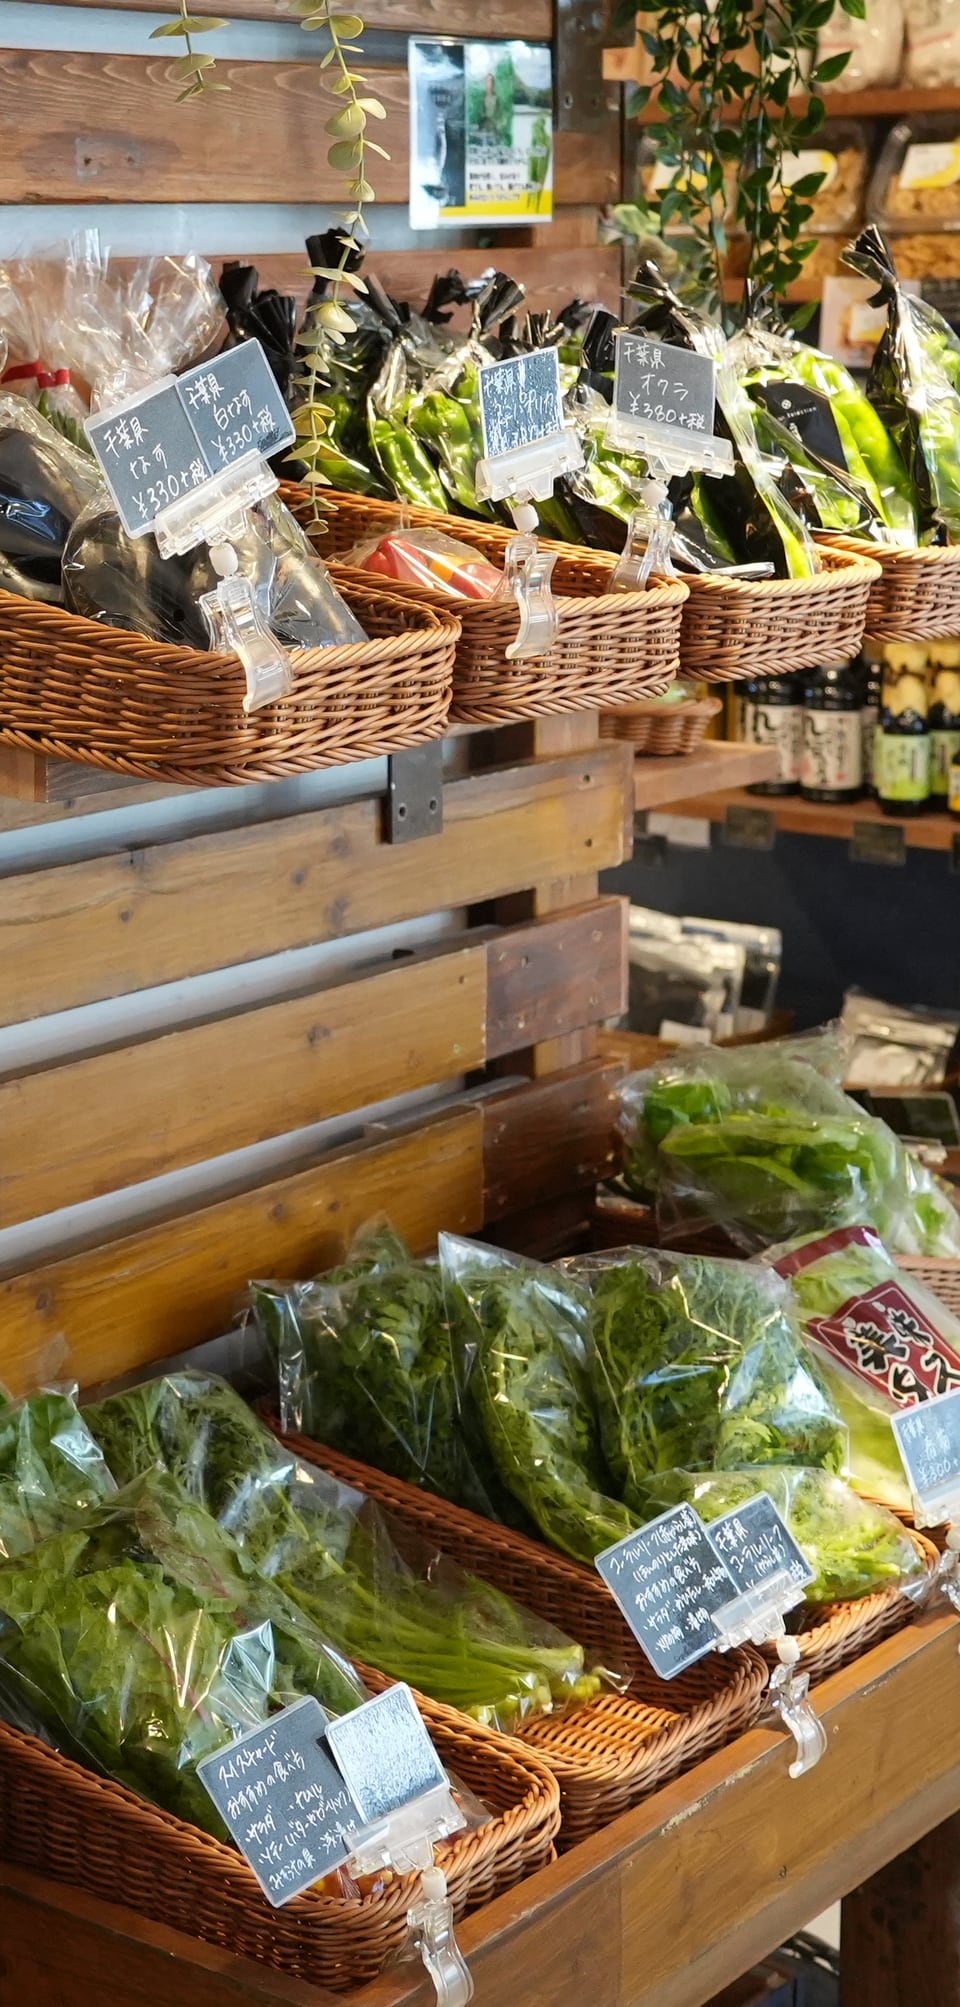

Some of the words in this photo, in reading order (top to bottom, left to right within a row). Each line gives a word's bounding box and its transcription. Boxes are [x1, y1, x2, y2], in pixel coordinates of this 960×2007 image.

[623, 342, 666, 369] 千葉県
[185, 373, 224, 409] 千葉県
[641, 373, 688, 401] オクラ
[629, 391, 705, 430] ¥380+税
[104, 417, 148, 458] 千葉県
[130, 443, 168, 479] なす
[714, 1517, 749, 1552] 千葉県
